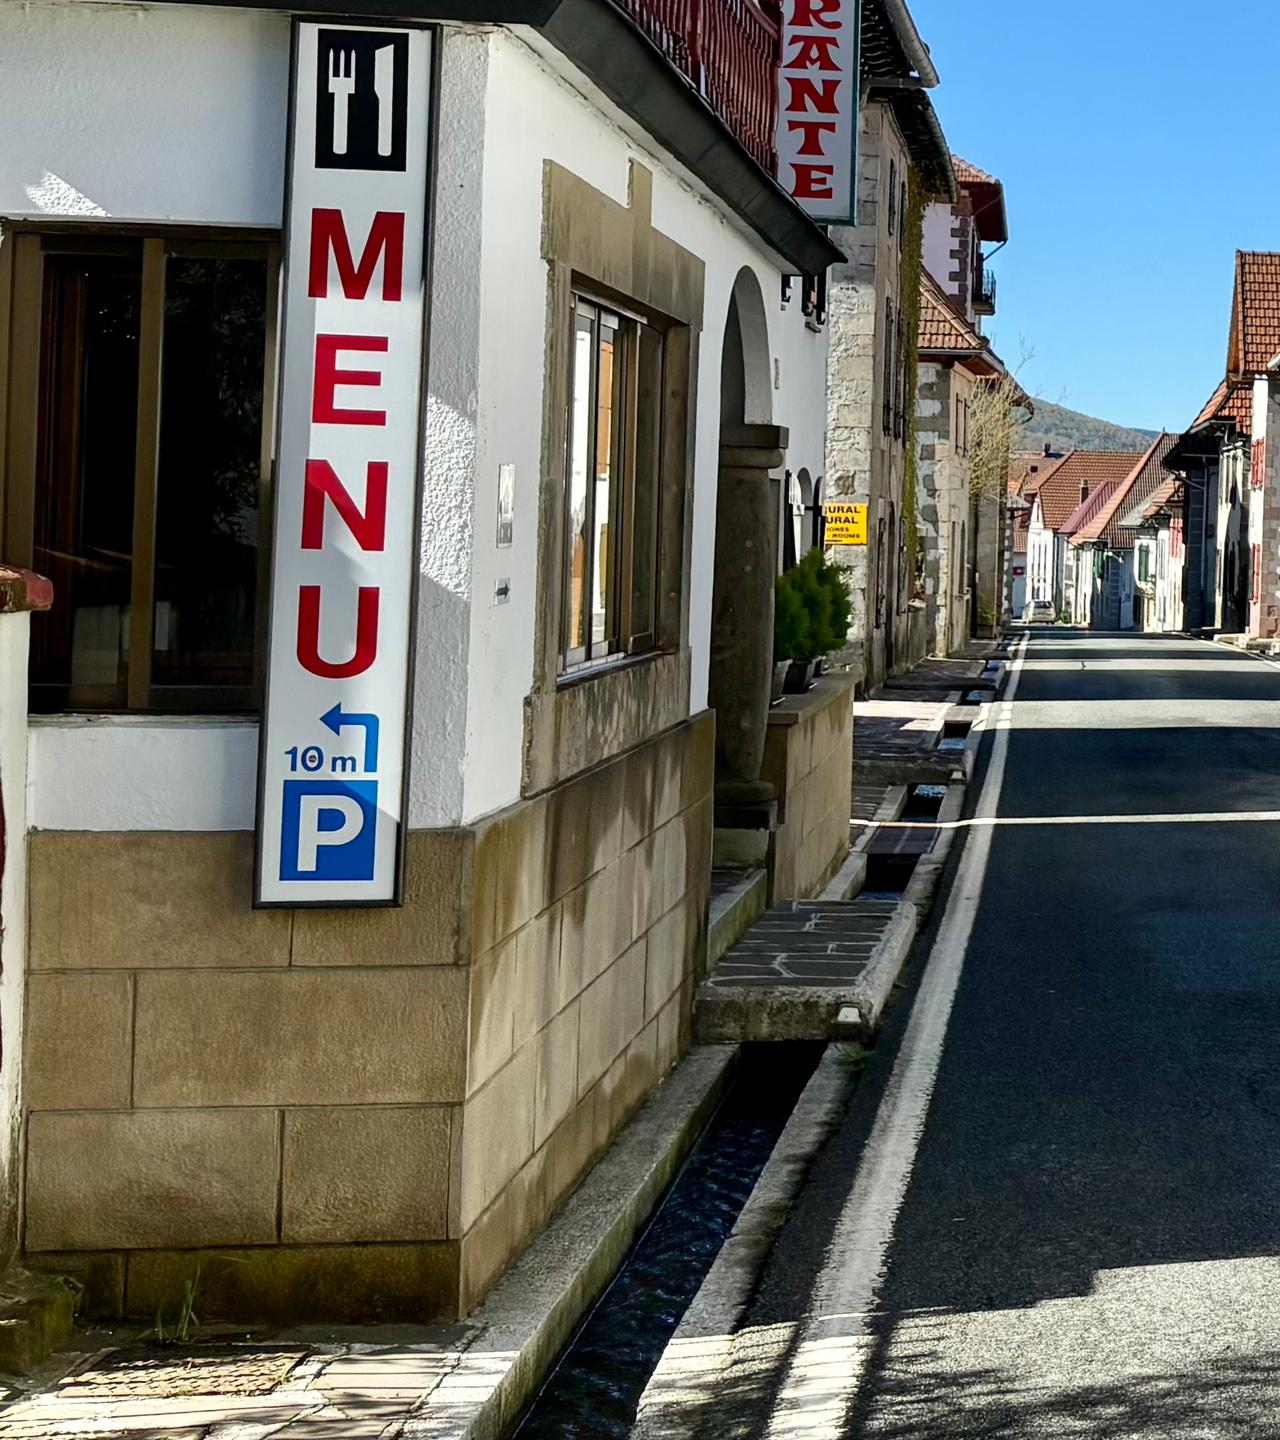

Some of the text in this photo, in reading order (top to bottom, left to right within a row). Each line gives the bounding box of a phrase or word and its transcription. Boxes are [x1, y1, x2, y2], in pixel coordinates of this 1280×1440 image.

[297, 208, 404, 678] MENU
[284, 745, 357, 773] 10 m
[296, 793, 365, 872] P
